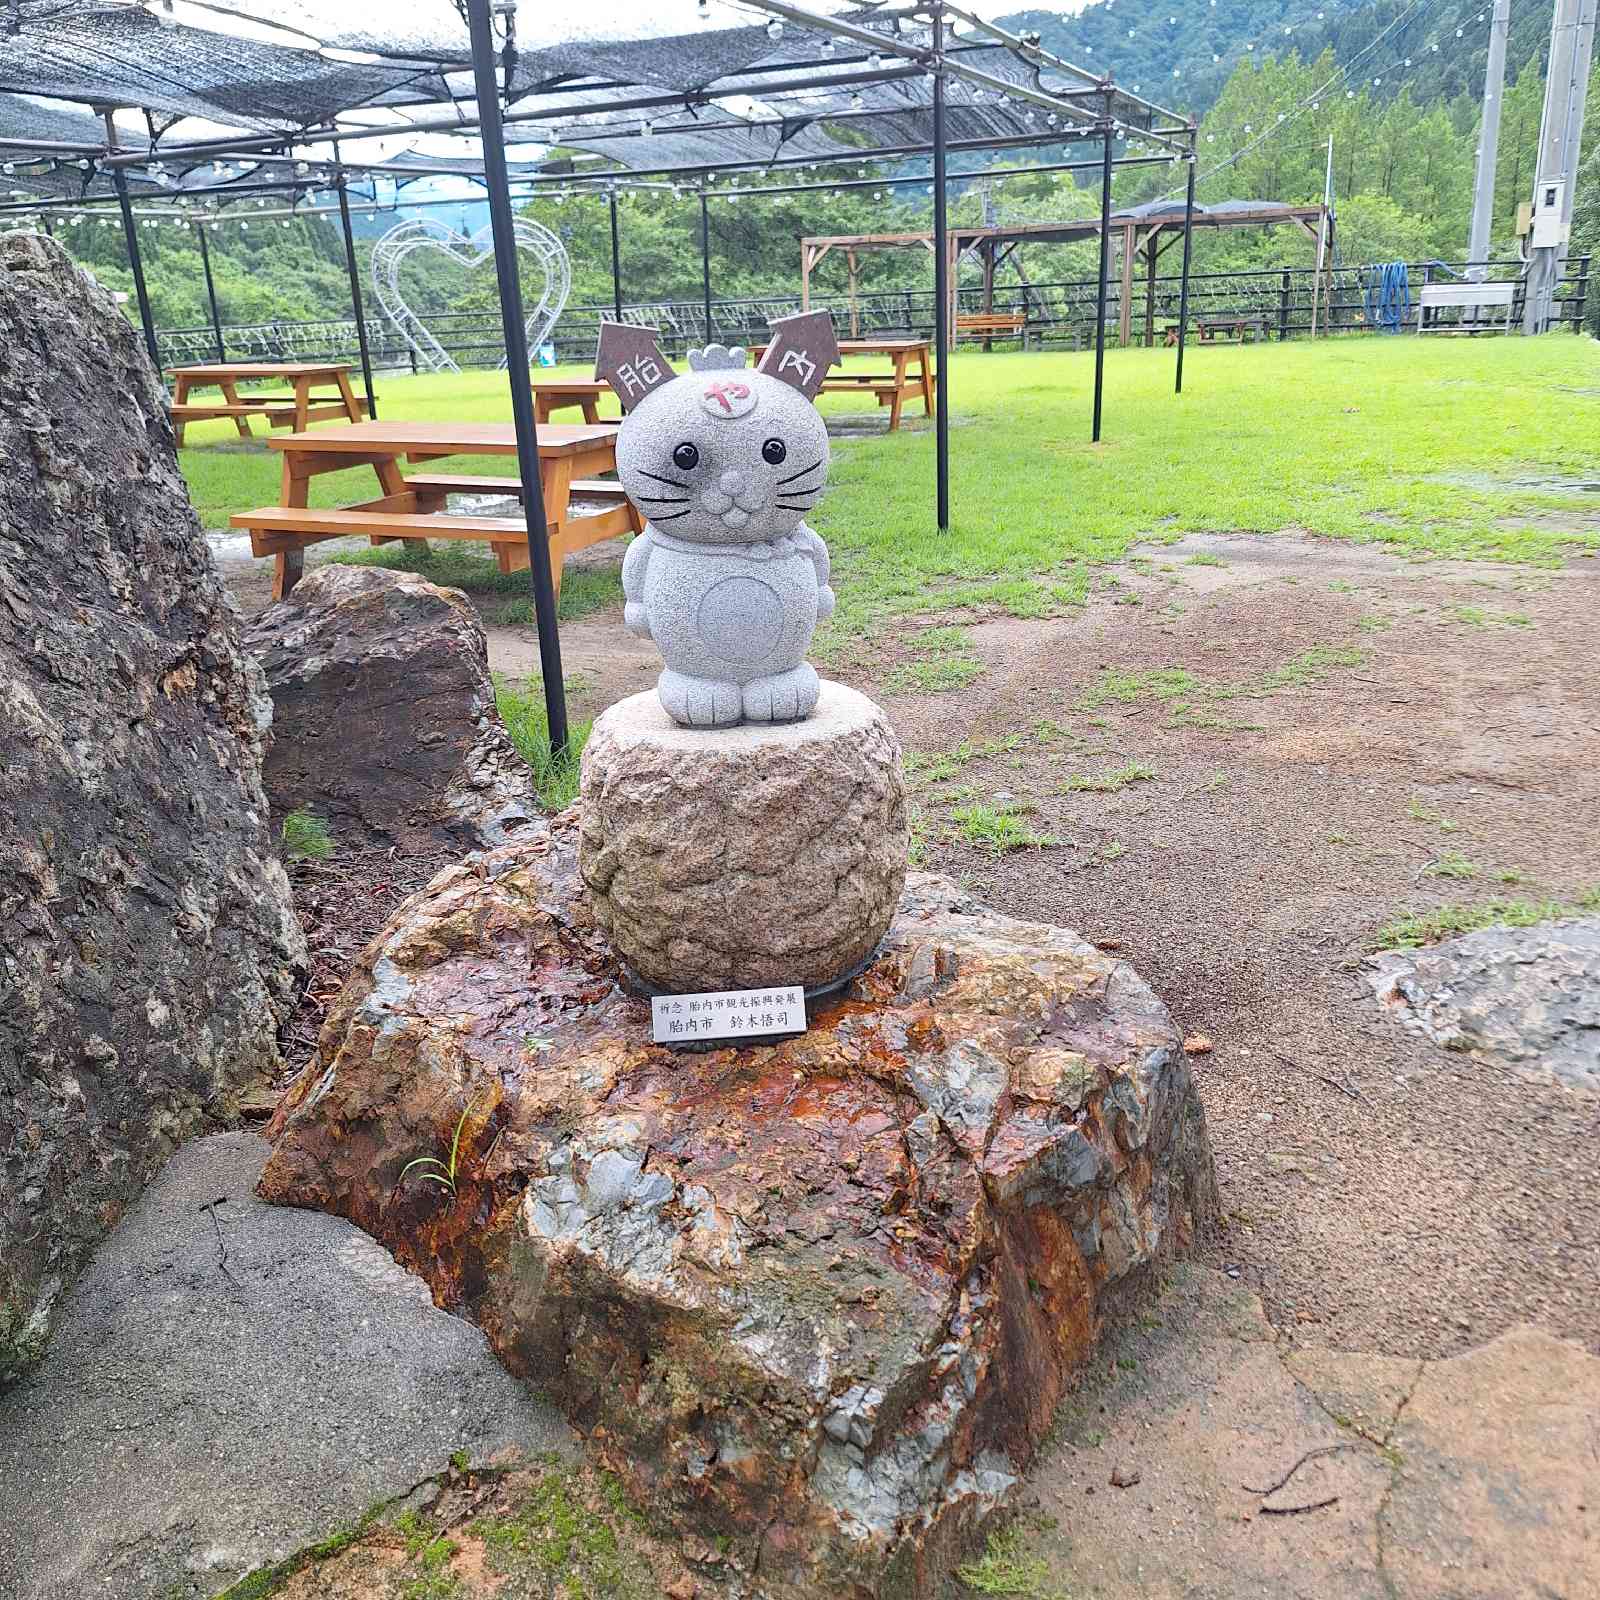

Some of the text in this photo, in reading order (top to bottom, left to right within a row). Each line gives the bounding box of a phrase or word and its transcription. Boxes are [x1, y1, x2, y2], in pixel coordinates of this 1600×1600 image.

[616, 354, 662, 397] 胎
[777, 350, 816, 386] 内
[703, 382, 751, 412] や
[669, 1011, 789, 1033] 胎内市 鈴木悟司
